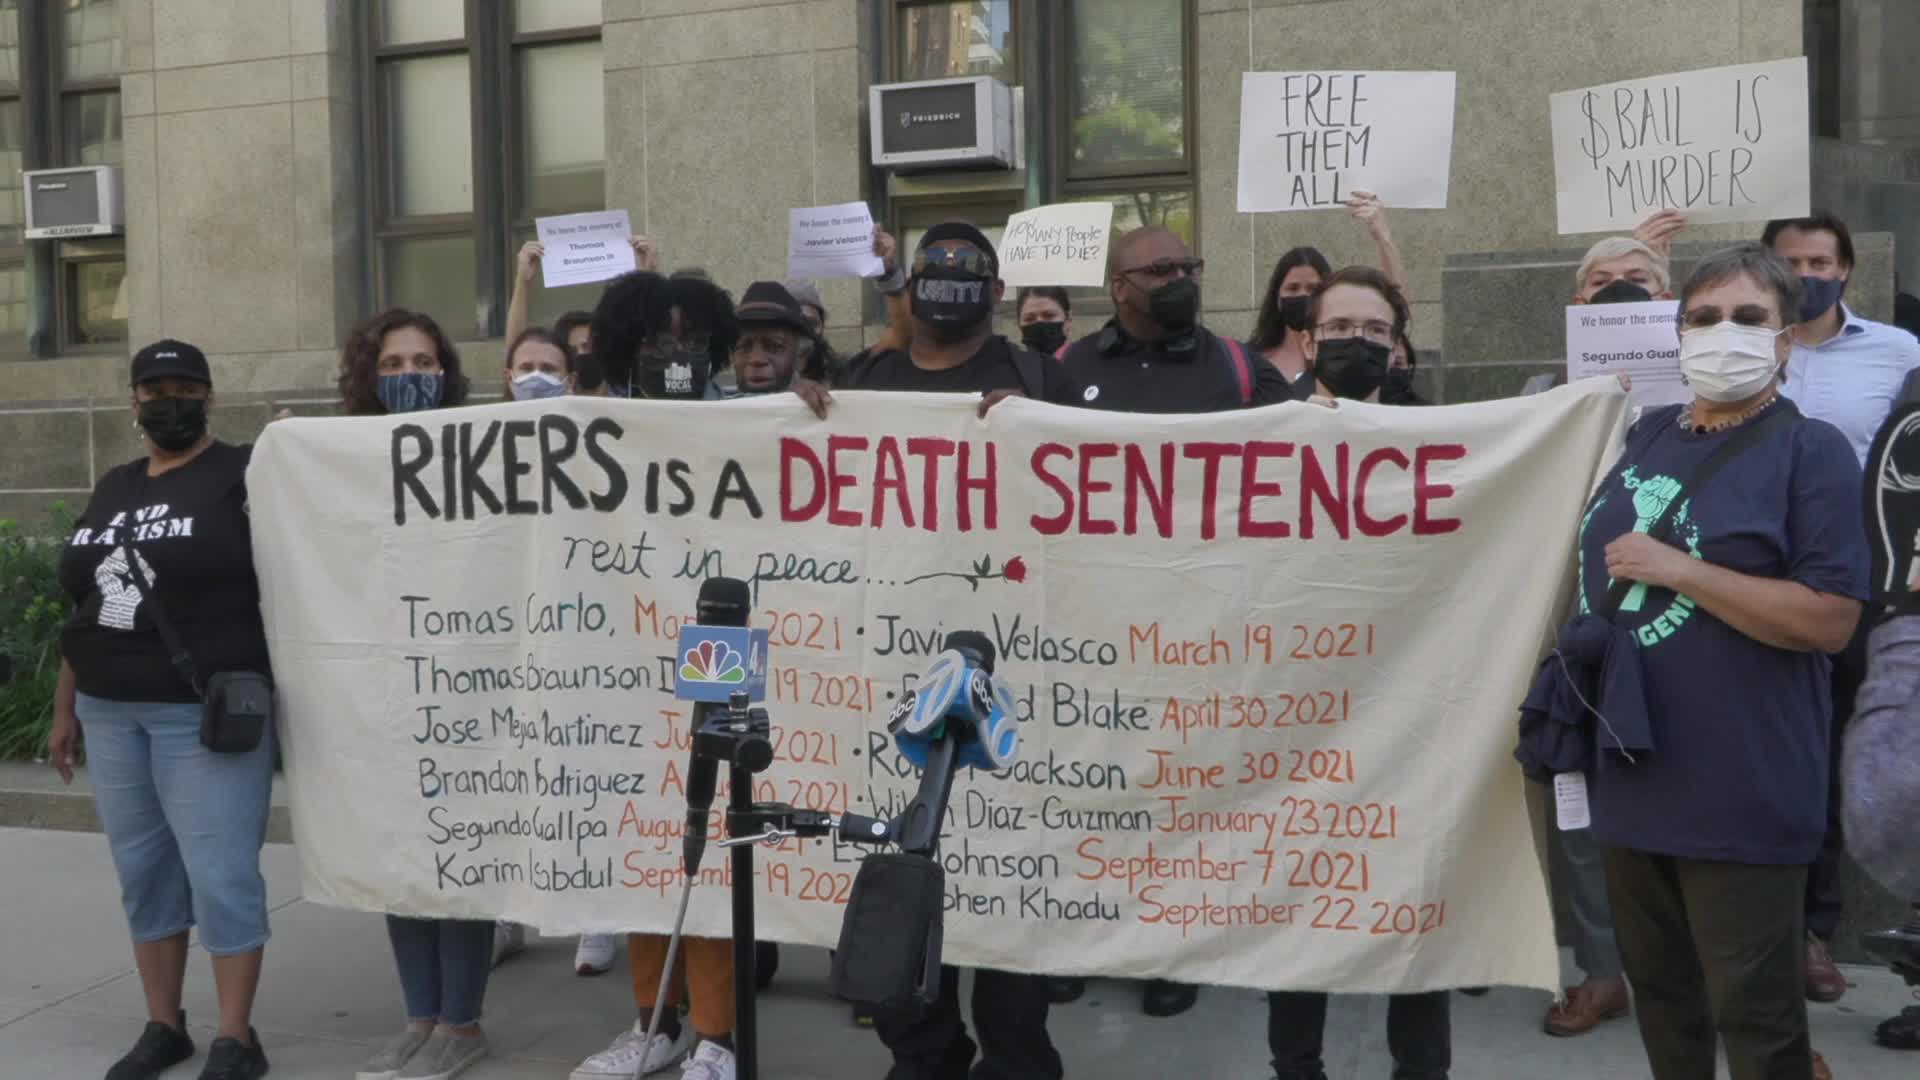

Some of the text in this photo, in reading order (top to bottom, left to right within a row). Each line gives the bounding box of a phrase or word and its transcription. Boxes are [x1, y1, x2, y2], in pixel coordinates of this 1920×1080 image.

[912, 112, 961, 122] FRIEDRICH
[1281, 73, 1368, 127] FREE
[1581, 74, 1769, 170] $BAIL IS
[1276, 126, 1371, 173] THEM
[1290, 171, 1347, 207] ALL
[1606, 148, 1758, 218] MURDER
[568, 241, 605, 251] Thomas
[1004, 244, 1101, 263] HAVE TO DIE?
[917, 278, 984, 303] UNITY
[1581, 316, 1597, 327] We
[1600, 314, 1627, 327] honor
[1630, 313, 1646, 325] the
[1582, 350, 1644, 365] Segundo
[665, 380, 692, 390] VOCAL
[392, 414, 1467, 540] RIKERS IS A DEATH SENTENCE
[72, 517, 194, 546] RAISM
[563, 531, 657, 578] rest
[672, 539, 722, 579] in
[400, 596, 514, 639] Tomas
[993, 612, 1118, 665] Velasco
[1129, 622, 1231, 665] March
[1244, 624, 1272, 664] 19
[1289, 623, 1376, 659] 2021
[775, 667, 800, 703] 19
[809, 671, 873, 712] 2021
[1053, 682, 1150, 731] Blake
[1161, 692, 1220, 744] April
[1227, 695, 1268, 728] 30
[1274, 688, 1351, 728] 2021
[412, 705, 483, 744] Jose
[1138, 749, 1225, 788] June
[1237, 751, 1280, 783] 30
[1288, 749, 1355, 783] 2021
[419, 758, 530, 798] Brandon
[966, 789, 1150, 832] Diaz-Guzman
[1157, 796, 1277, 850] January
[1281, 796, 1320, 837] 23
[1327, 802, 1396, 839] 2021
[427, 806, 530, 851] Segundo
[1076, 837, 1248, 894] September
[1253, 850, 1275, 885] 7
[1285, 850, 1369, 891] 2021
[435, 853, 523, 890] Karim
[767, 862, 791, 896] 19
[799, 867, 851, 904] 202
[1021, 886, 1120, 920] Khadu
[1137, 885, 1304, 937] September
[1311, 895, 1359, 930] 22
[1369, 899, 1446, 934] 2021
